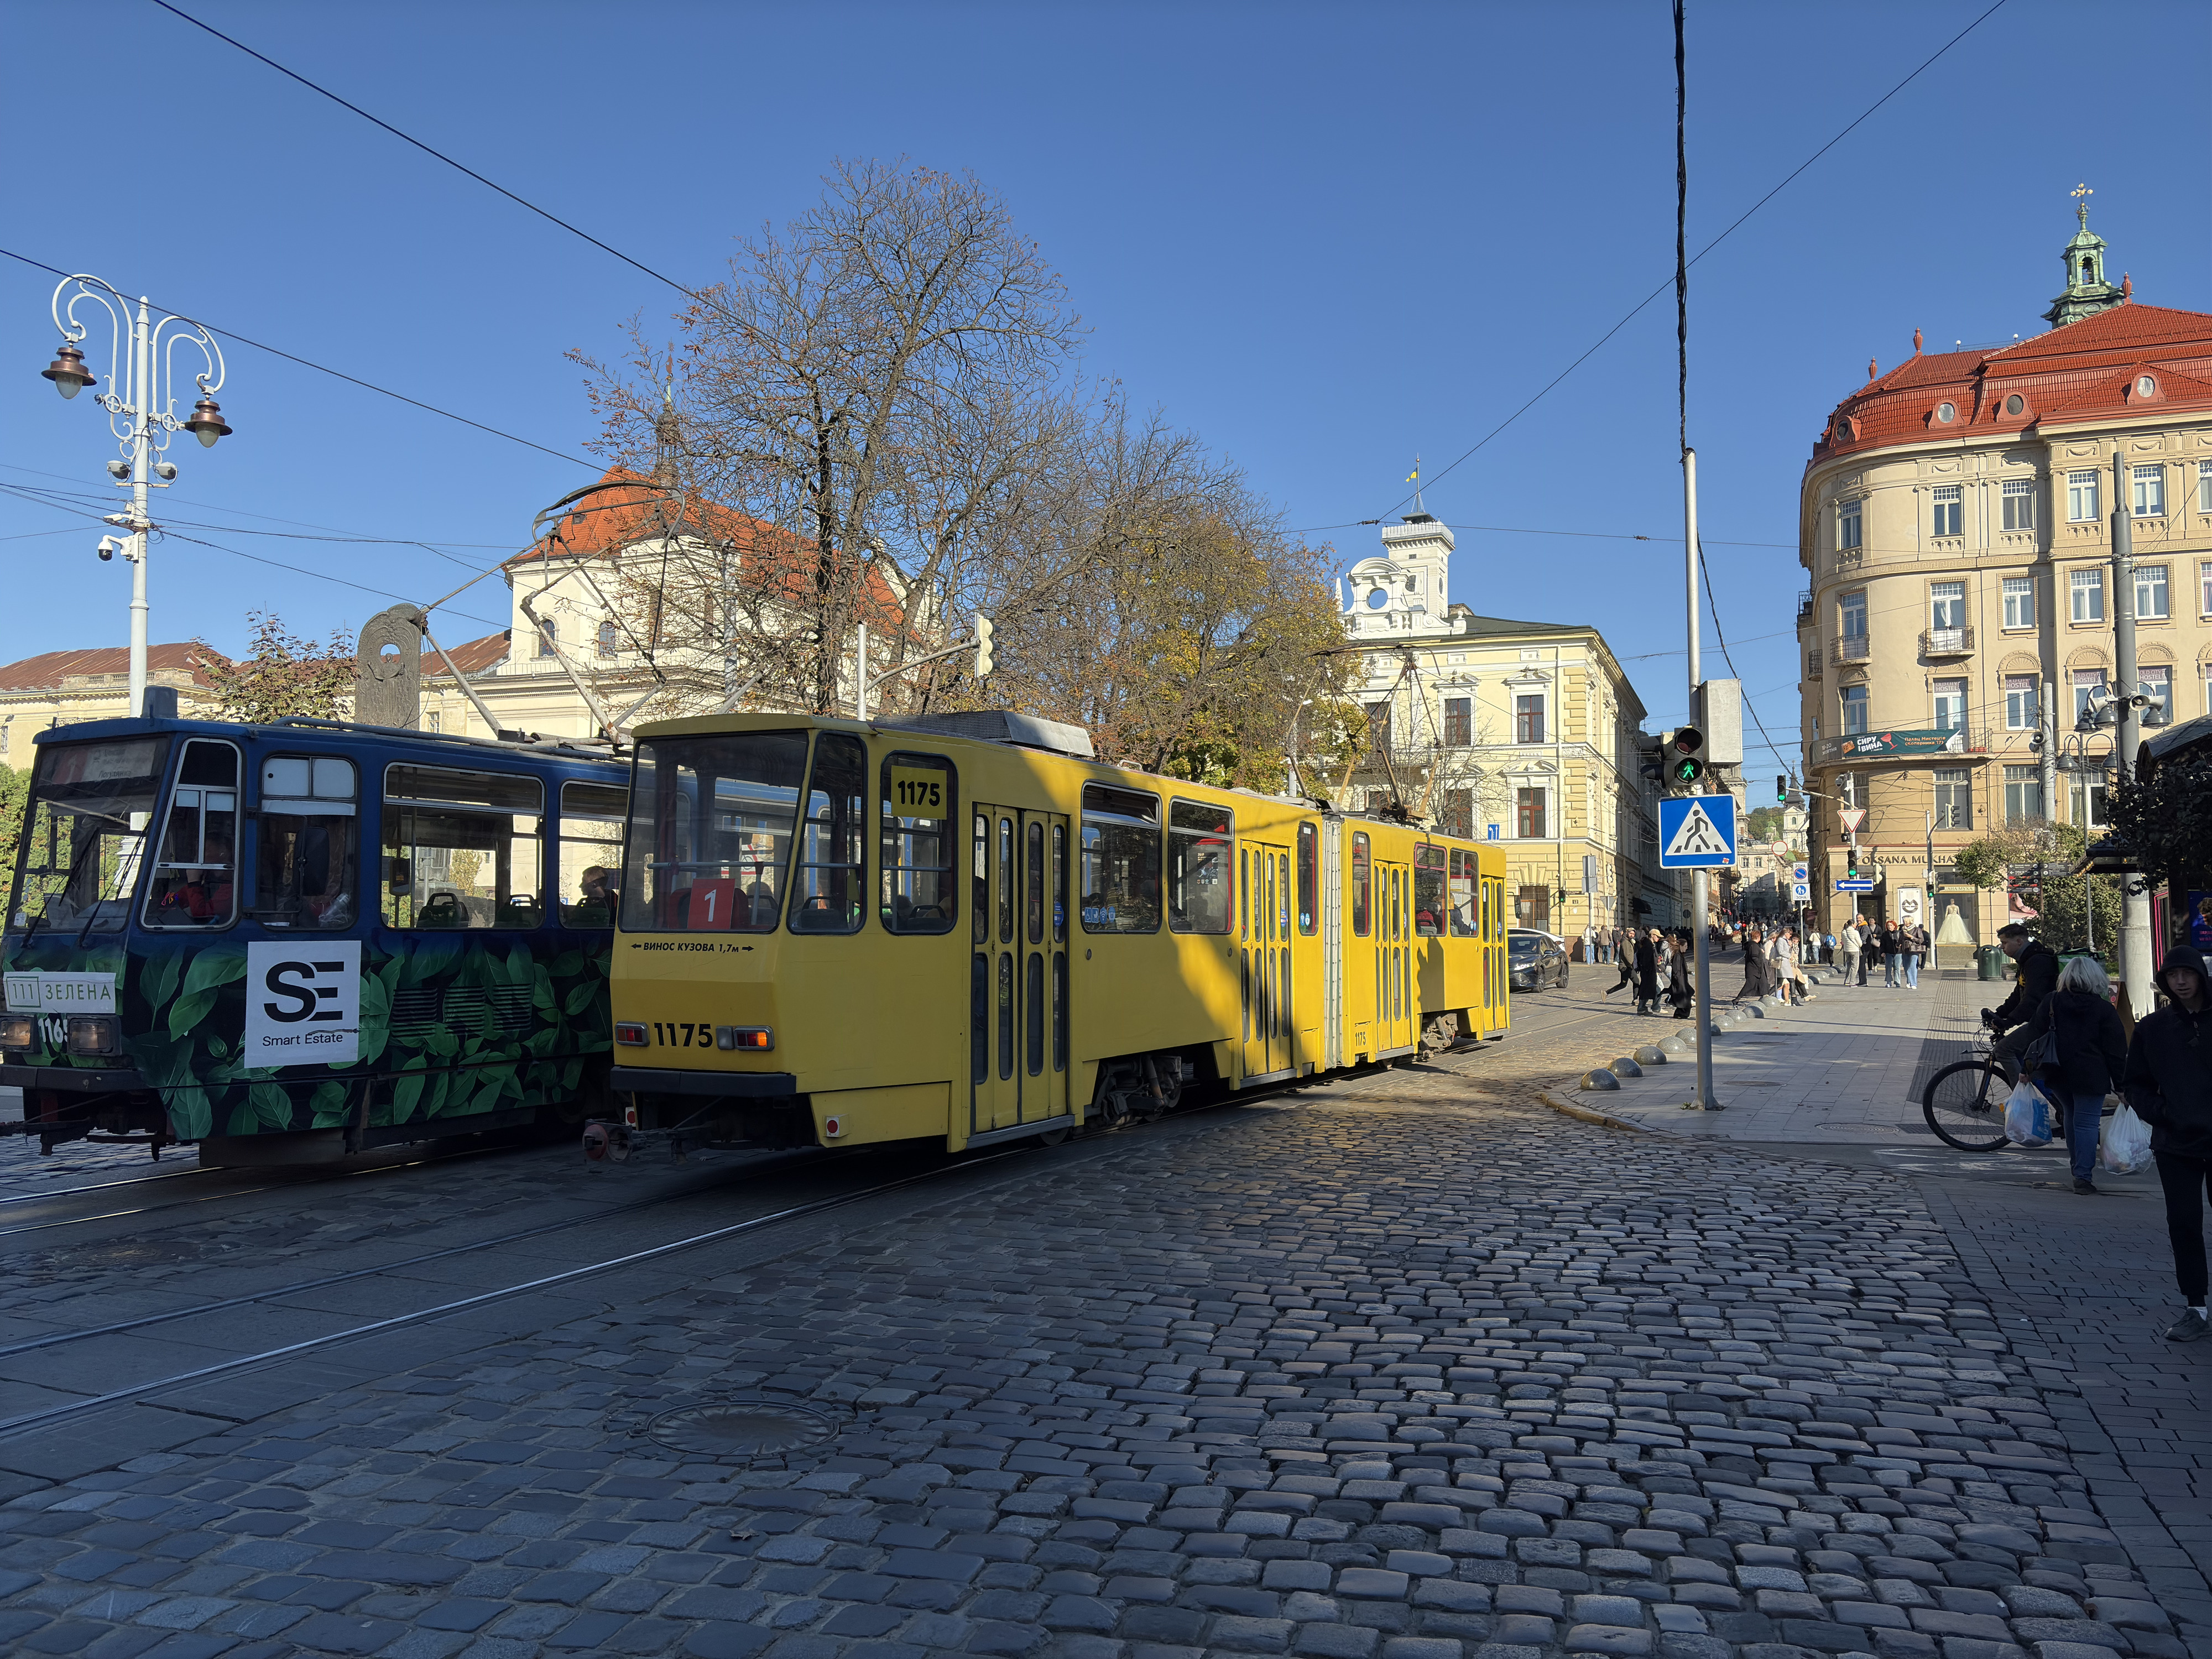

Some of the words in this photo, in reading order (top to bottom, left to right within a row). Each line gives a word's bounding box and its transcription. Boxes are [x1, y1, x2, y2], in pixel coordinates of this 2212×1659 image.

[1857, 736, 1877, 745] СИРУ
[1861, 740, 1883, 752] ВИНА
[898, 780, 940, 807] 1175
[1862, 855, 1908, 864] OKSANA
[705, 889, 717, 922] 1
[643, 942, 675, 951] ВИНОС
[677, 942, 714, 952] КУЗОВА
[719, 943, 739, 953] 1,7м
[13, 983, 33, 999] 111
[45, 984, 111, 1000] ЗЕЛЕНА
[264, 961, 344, 1022] SE
[262, 1035, 300, 1046] Smart
[305, 1033, 343, 1045] Estate
[654, 1022, 713, 1048] 1175
[1355, 1031, 1366, 1046] 1175
